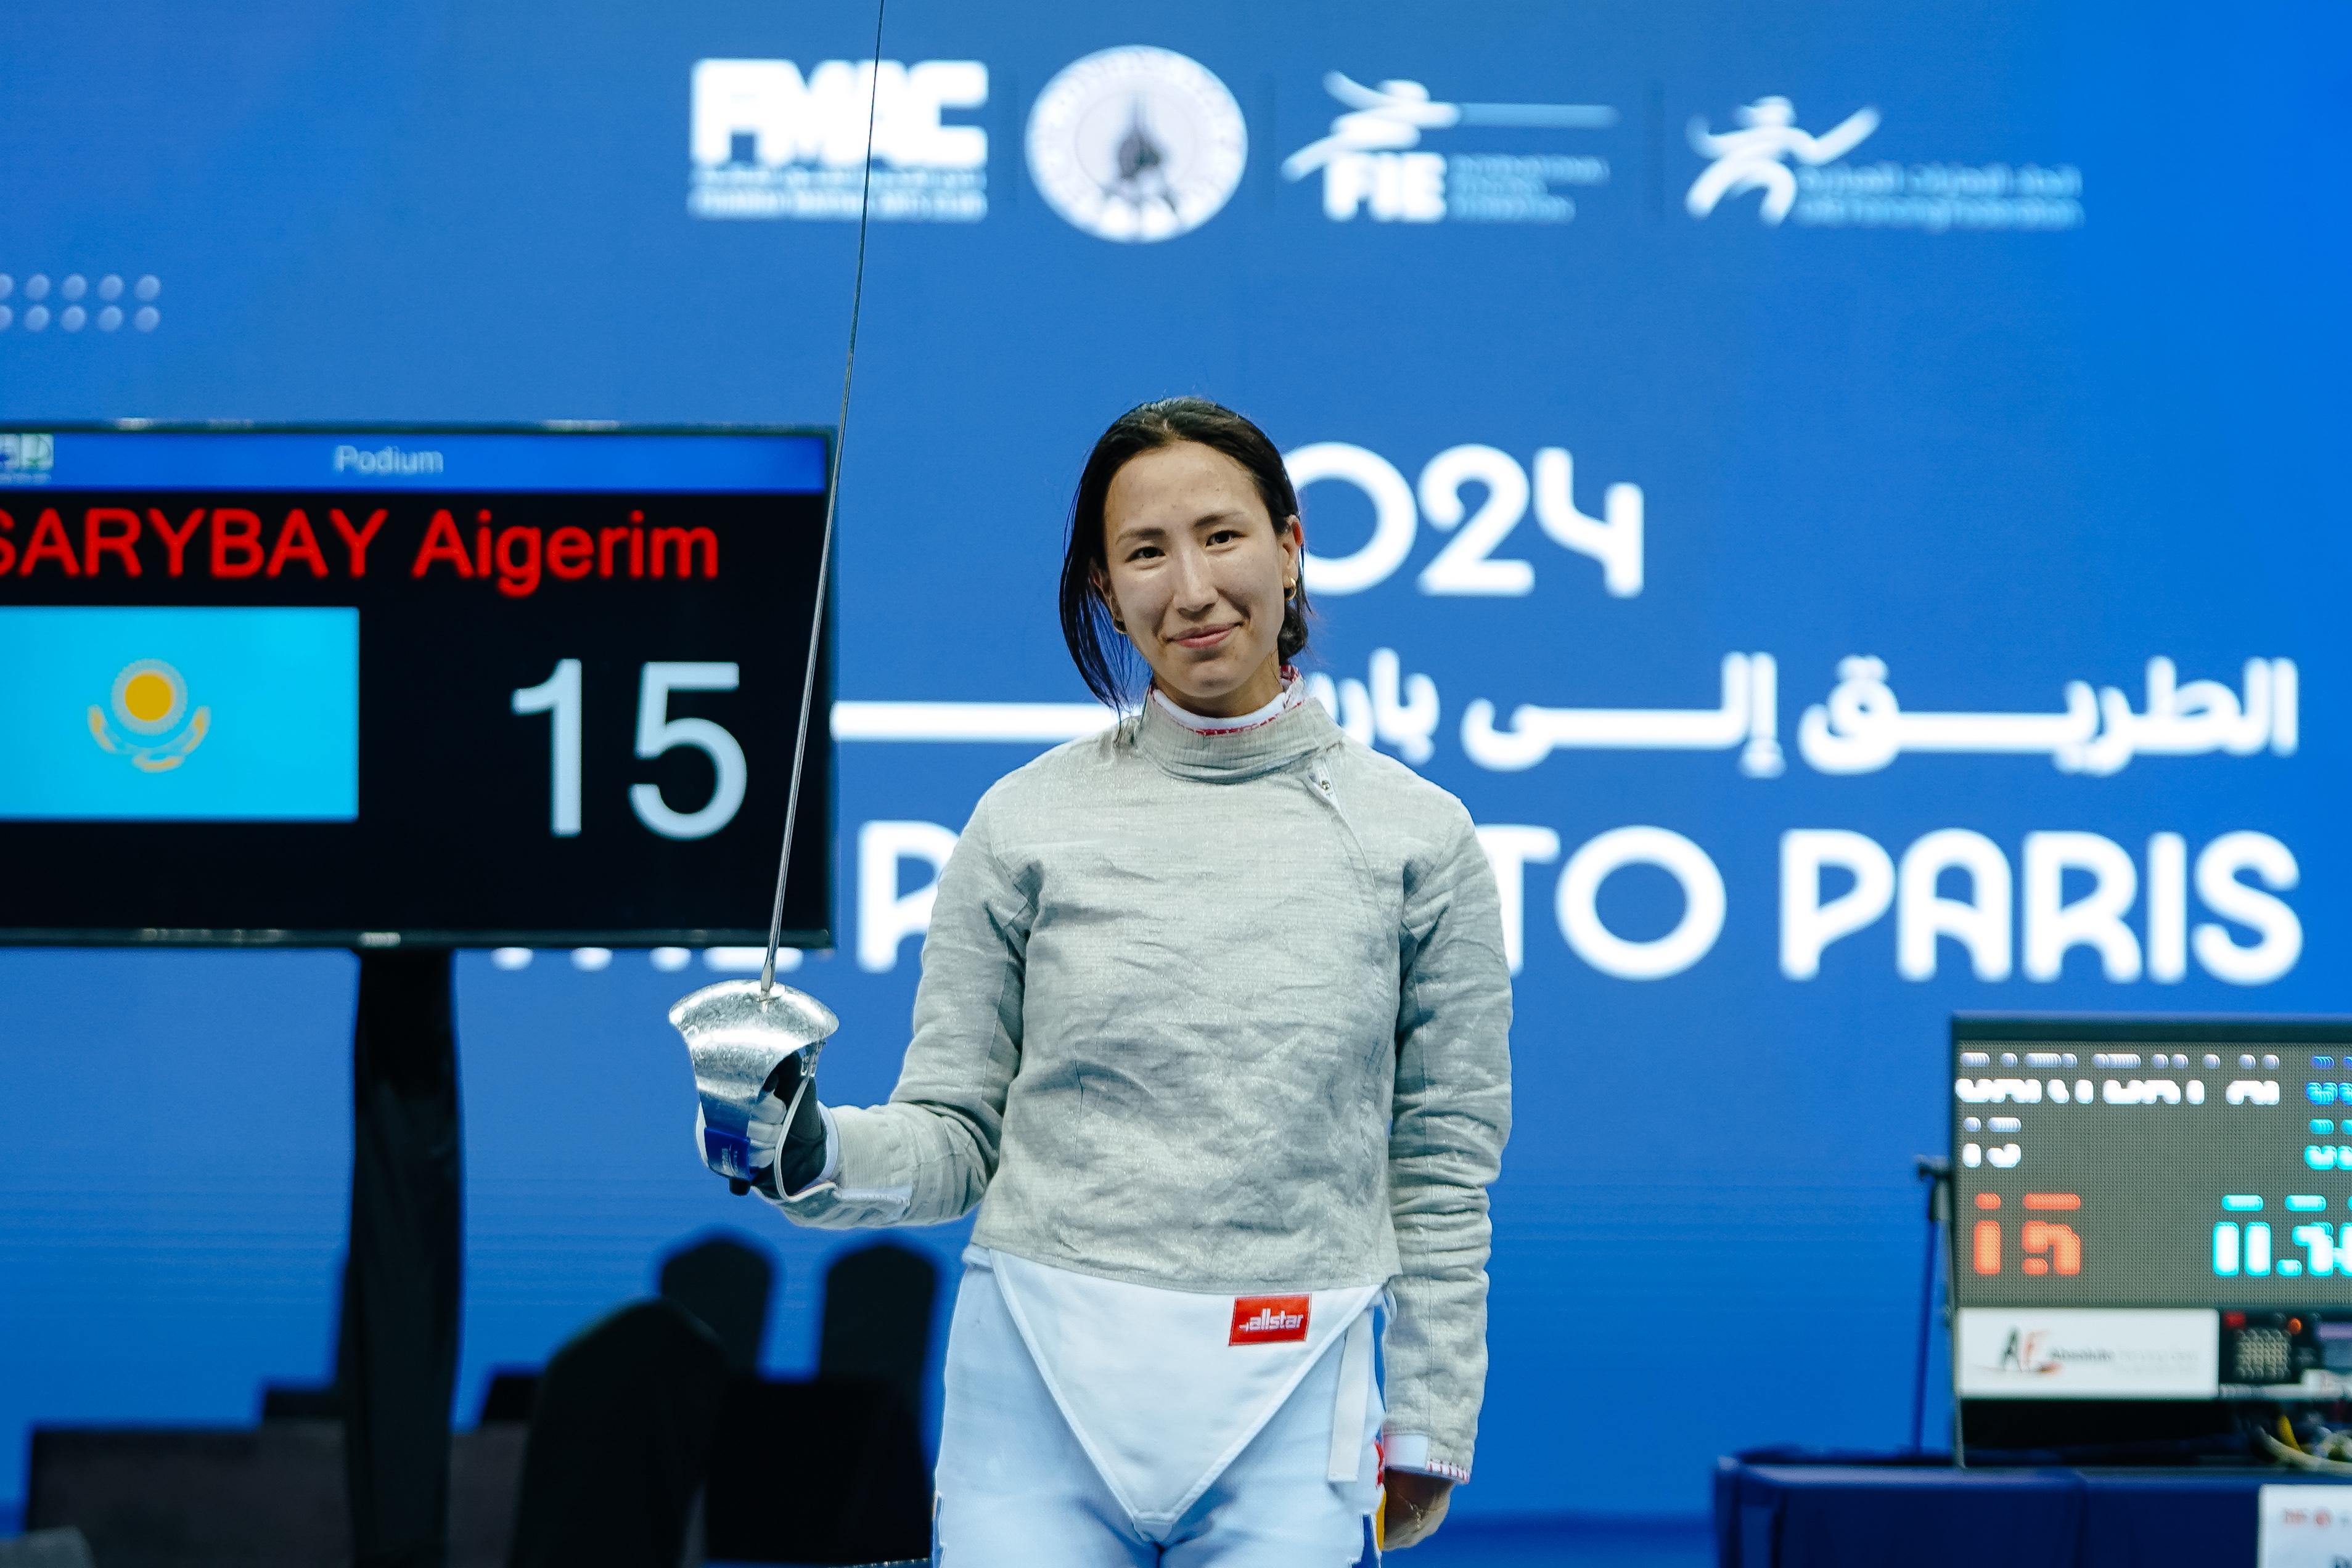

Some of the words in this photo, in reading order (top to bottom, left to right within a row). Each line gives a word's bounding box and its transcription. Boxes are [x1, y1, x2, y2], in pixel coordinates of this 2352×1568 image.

[692, 59, 989, 168] FMAC
[1324, 151, 1446, 222] FIE
[334, 445, 444, 474] Podium
[412, 508, 718, 597] Aigerim
[1284, 441, 1644, 597] 024
[511, 658, 747, 839] 15
[1779, 828, 2303, 984] PARIS
[1248, 1307, 1304, 1331] allstar
